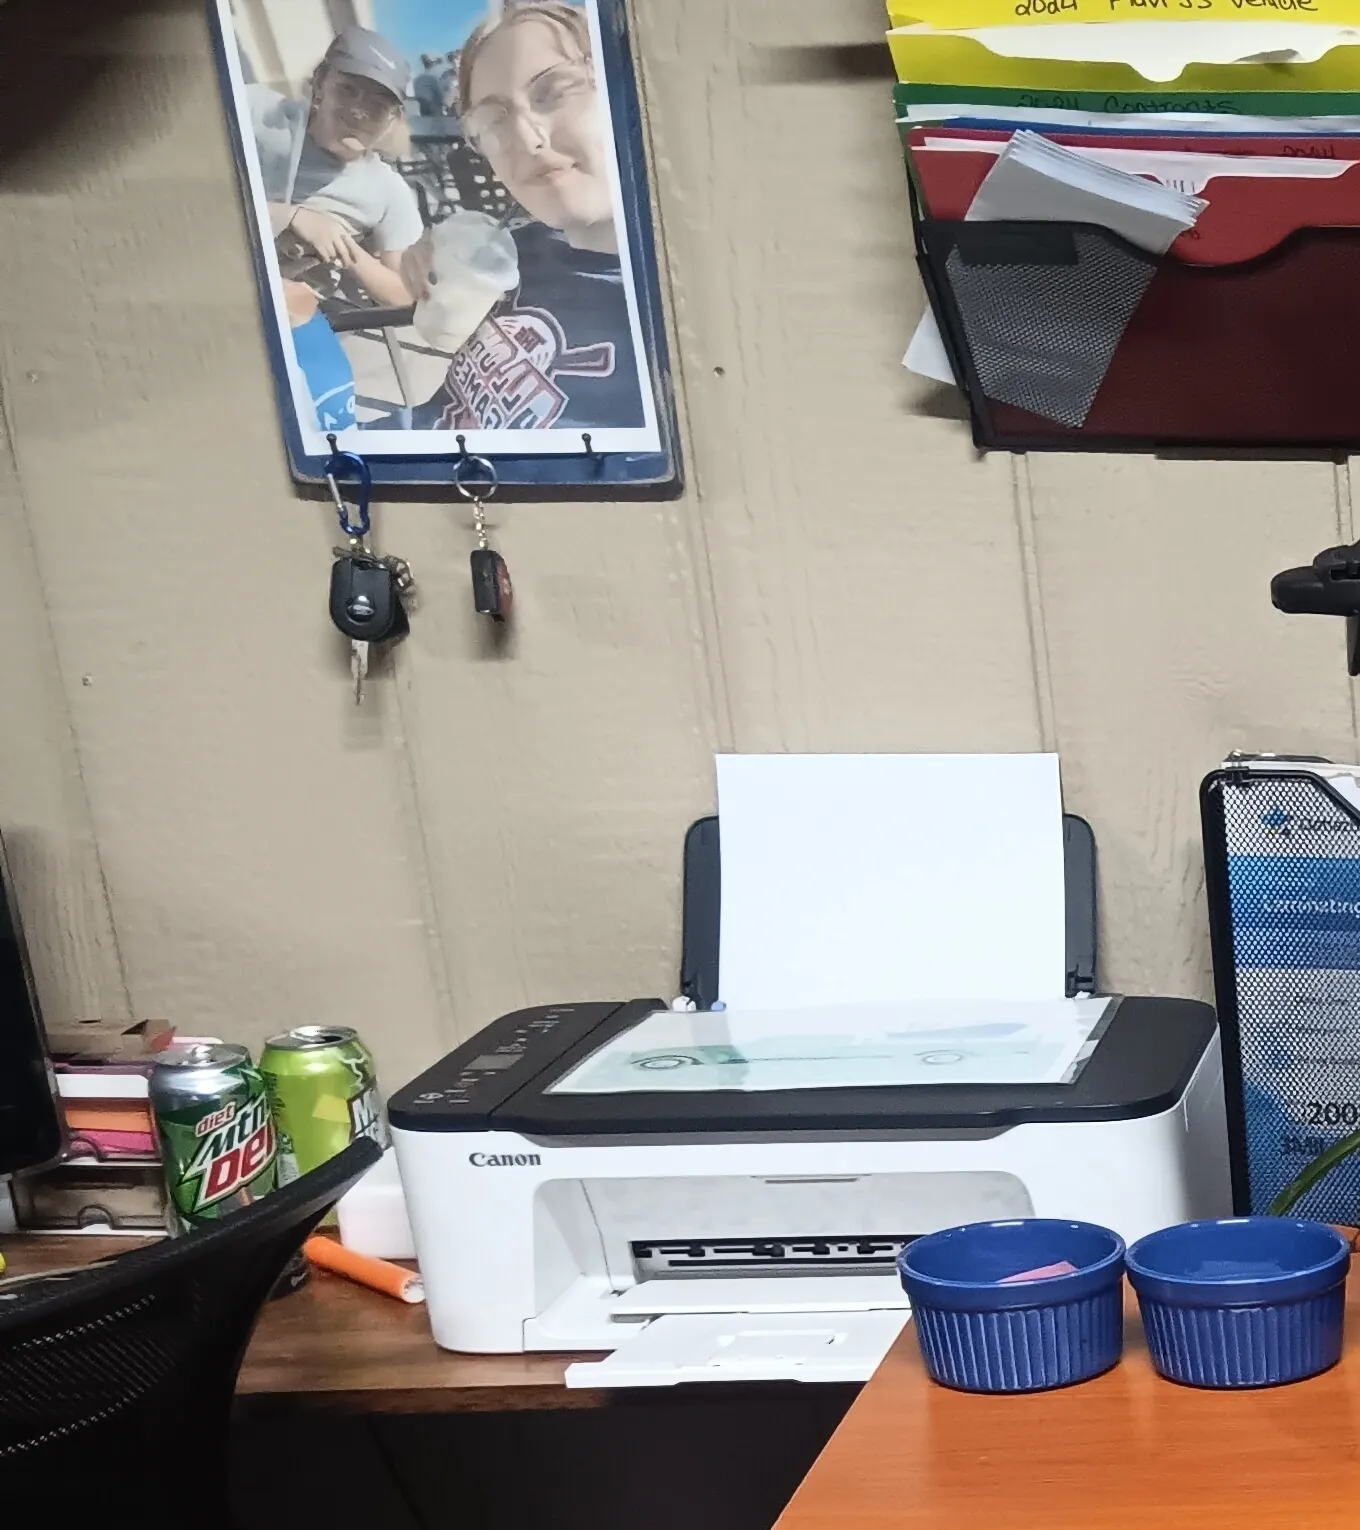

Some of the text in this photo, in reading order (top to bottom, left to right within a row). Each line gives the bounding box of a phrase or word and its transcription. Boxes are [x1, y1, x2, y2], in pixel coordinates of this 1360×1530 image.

[196, 1103, 236, 1137] diet
[197, 1103, 269, 1168] Mtn
[468, 1151, 542, 1168] Canon
